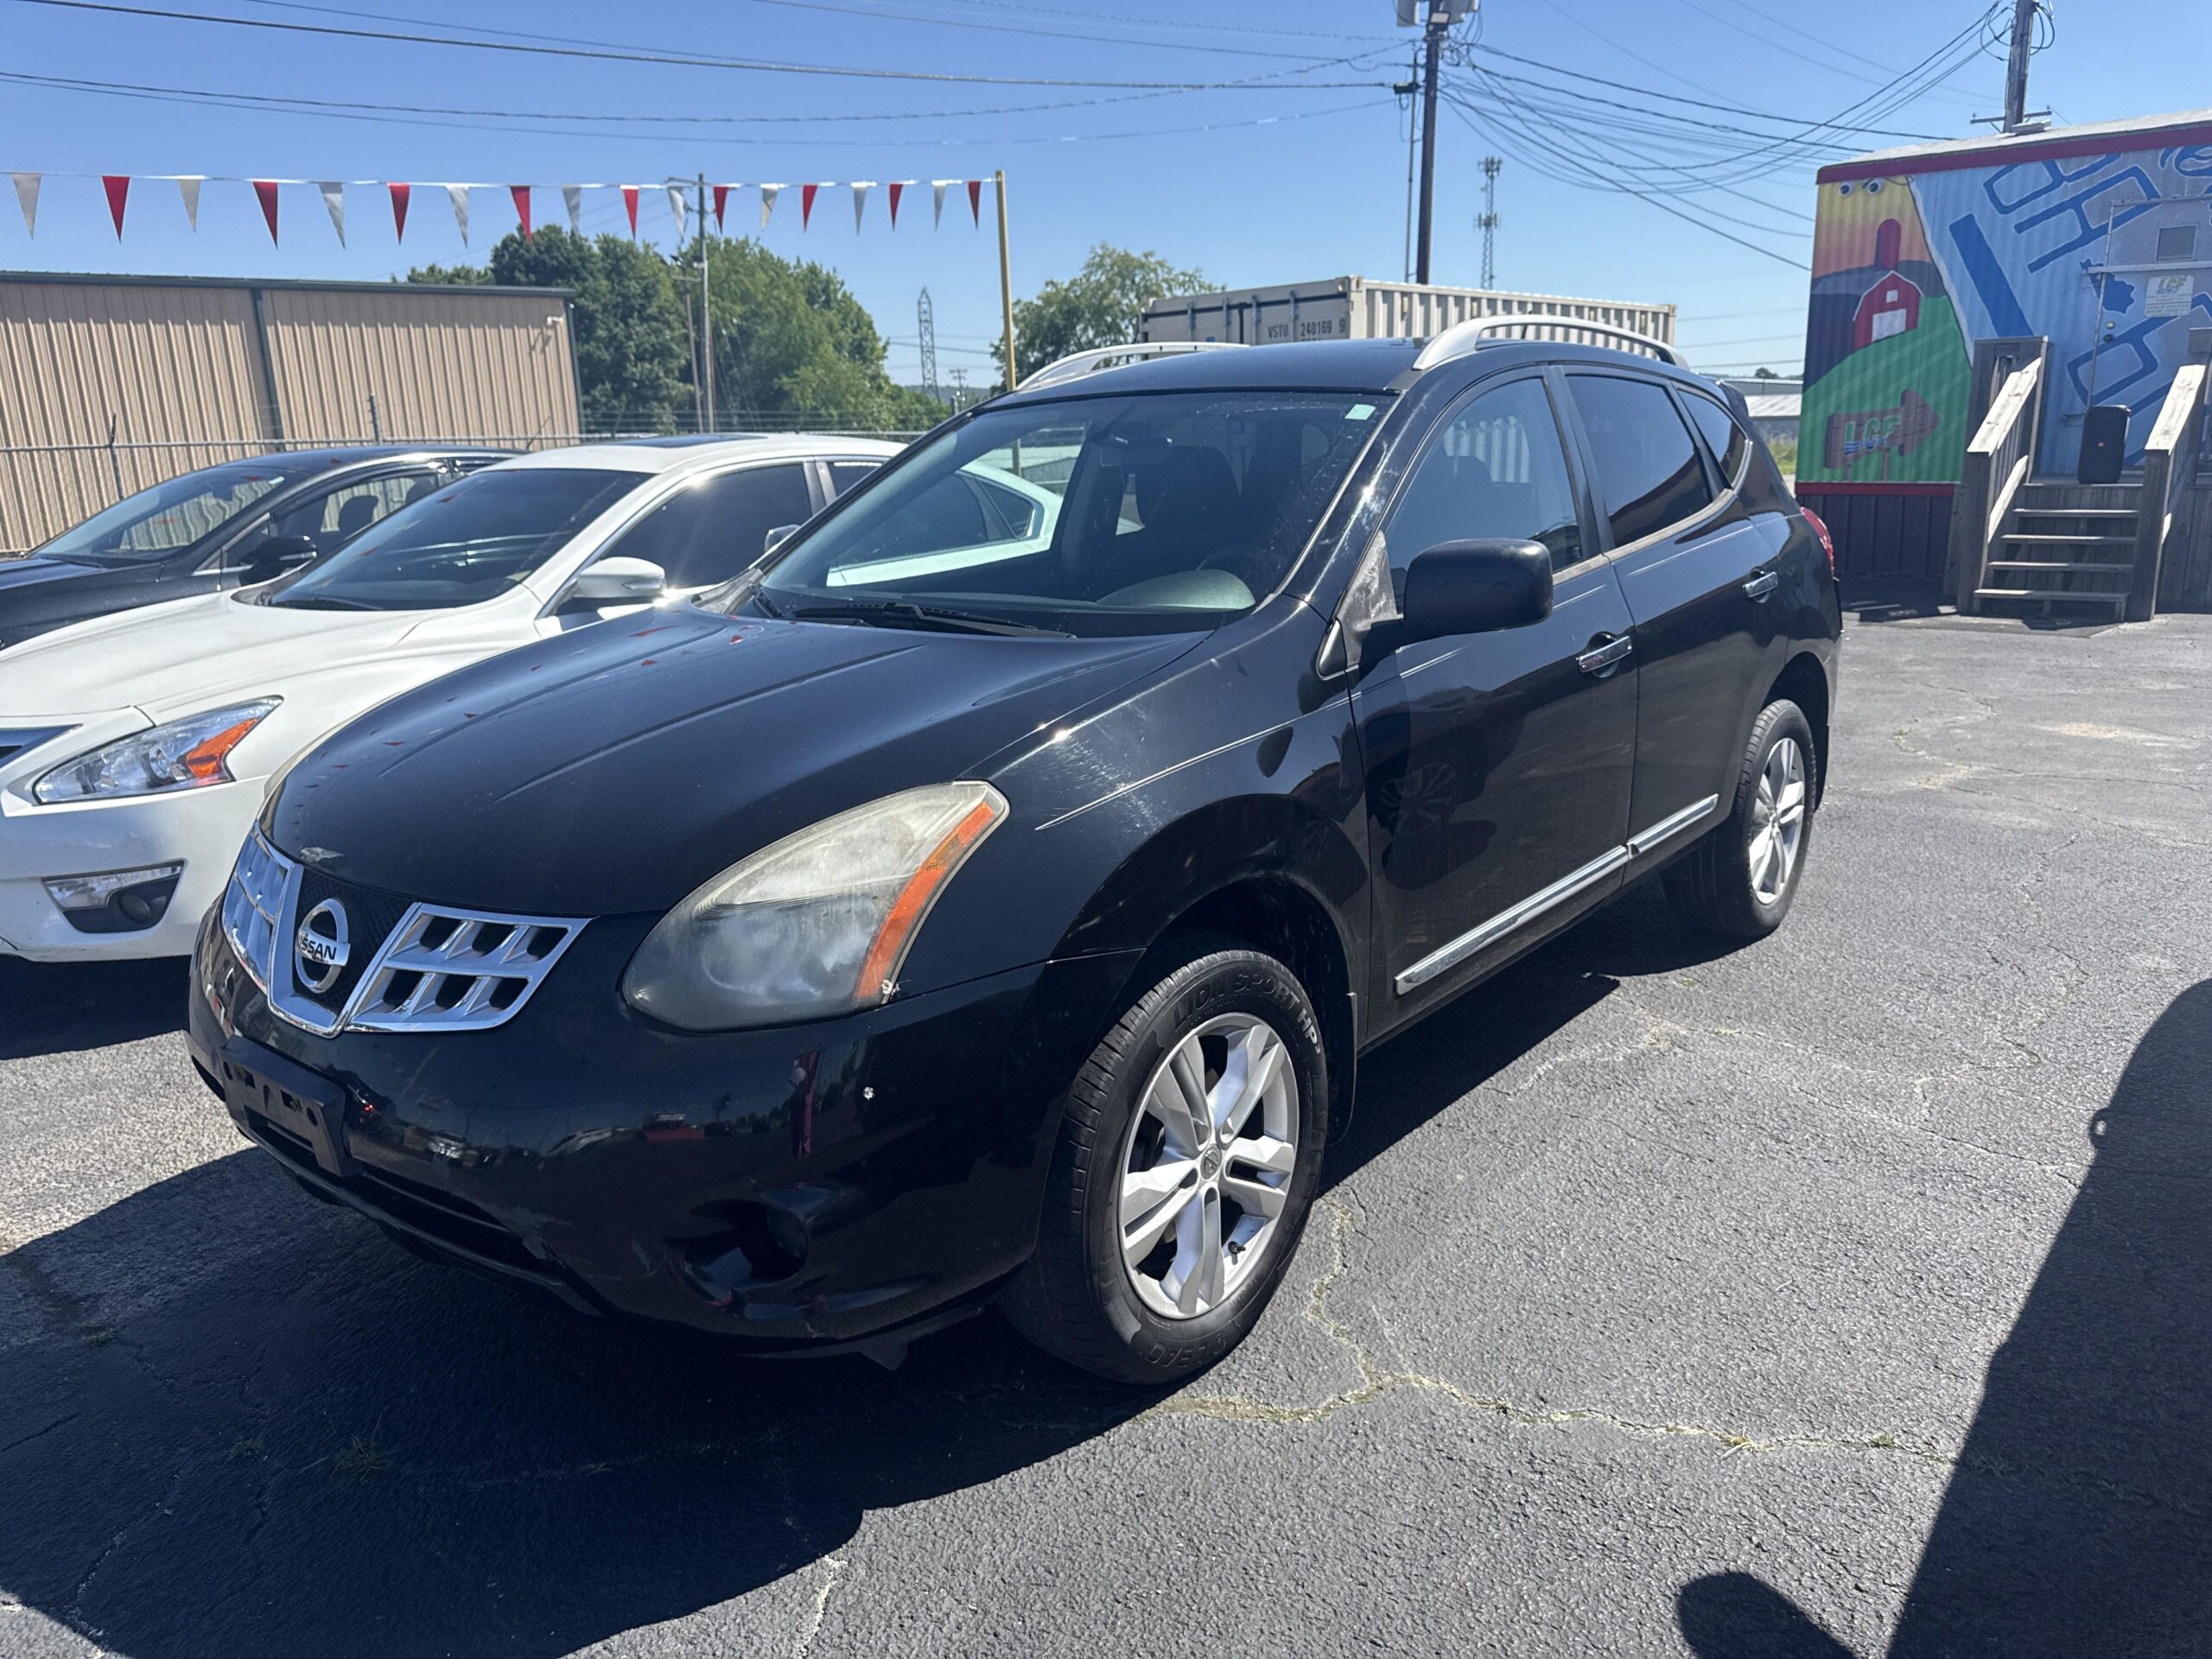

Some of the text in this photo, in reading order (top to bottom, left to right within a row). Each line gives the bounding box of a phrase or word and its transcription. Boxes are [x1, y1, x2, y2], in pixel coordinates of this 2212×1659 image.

[1267, 316, 1346, 340] VSTU 240169 9
[1233, 973, 1300, 1010] SPORT
